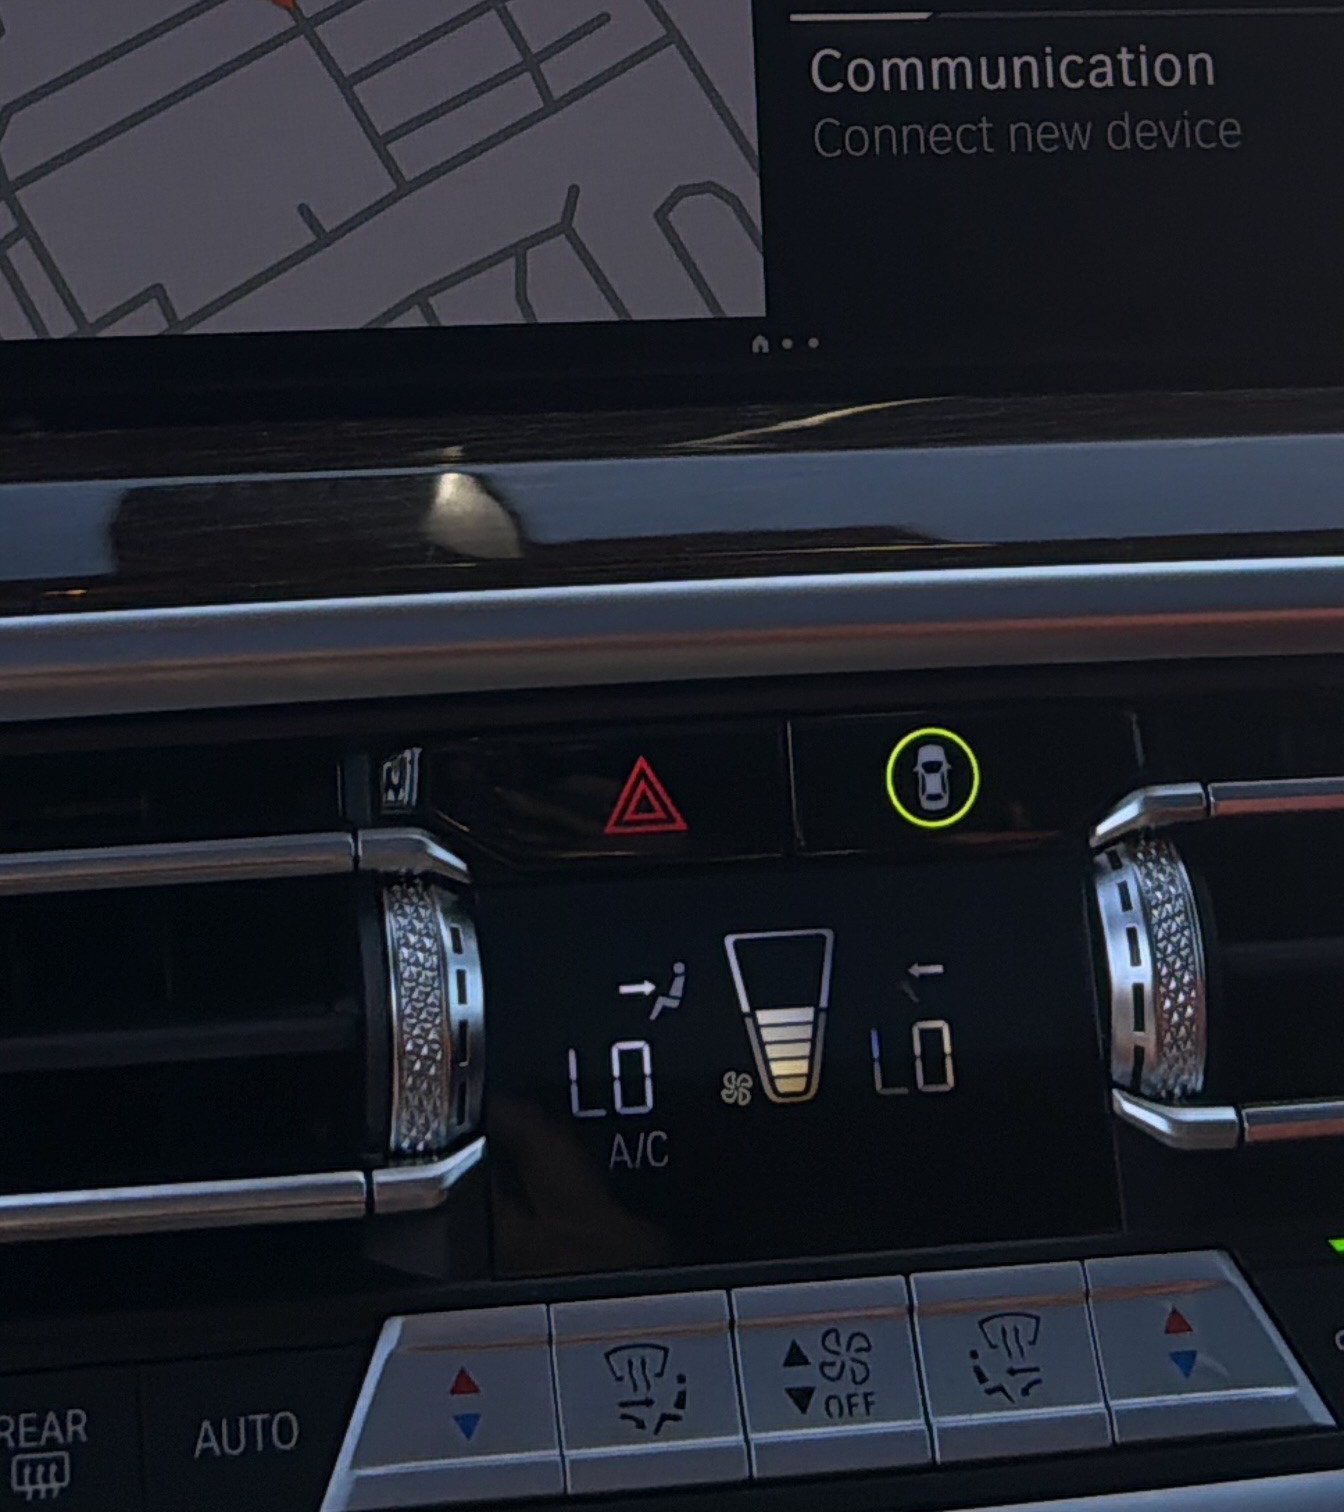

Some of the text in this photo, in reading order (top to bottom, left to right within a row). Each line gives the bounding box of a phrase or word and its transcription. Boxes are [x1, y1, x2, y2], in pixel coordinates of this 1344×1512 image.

[812, 45, 1214, 92] Communication
[815, 111, 1241, 157] Connect new device
[610, 1131, 668, 1168] A/C
[824, 1391, 876, 1419] OFF
[195, 1412, 298, 1458] AUTO
